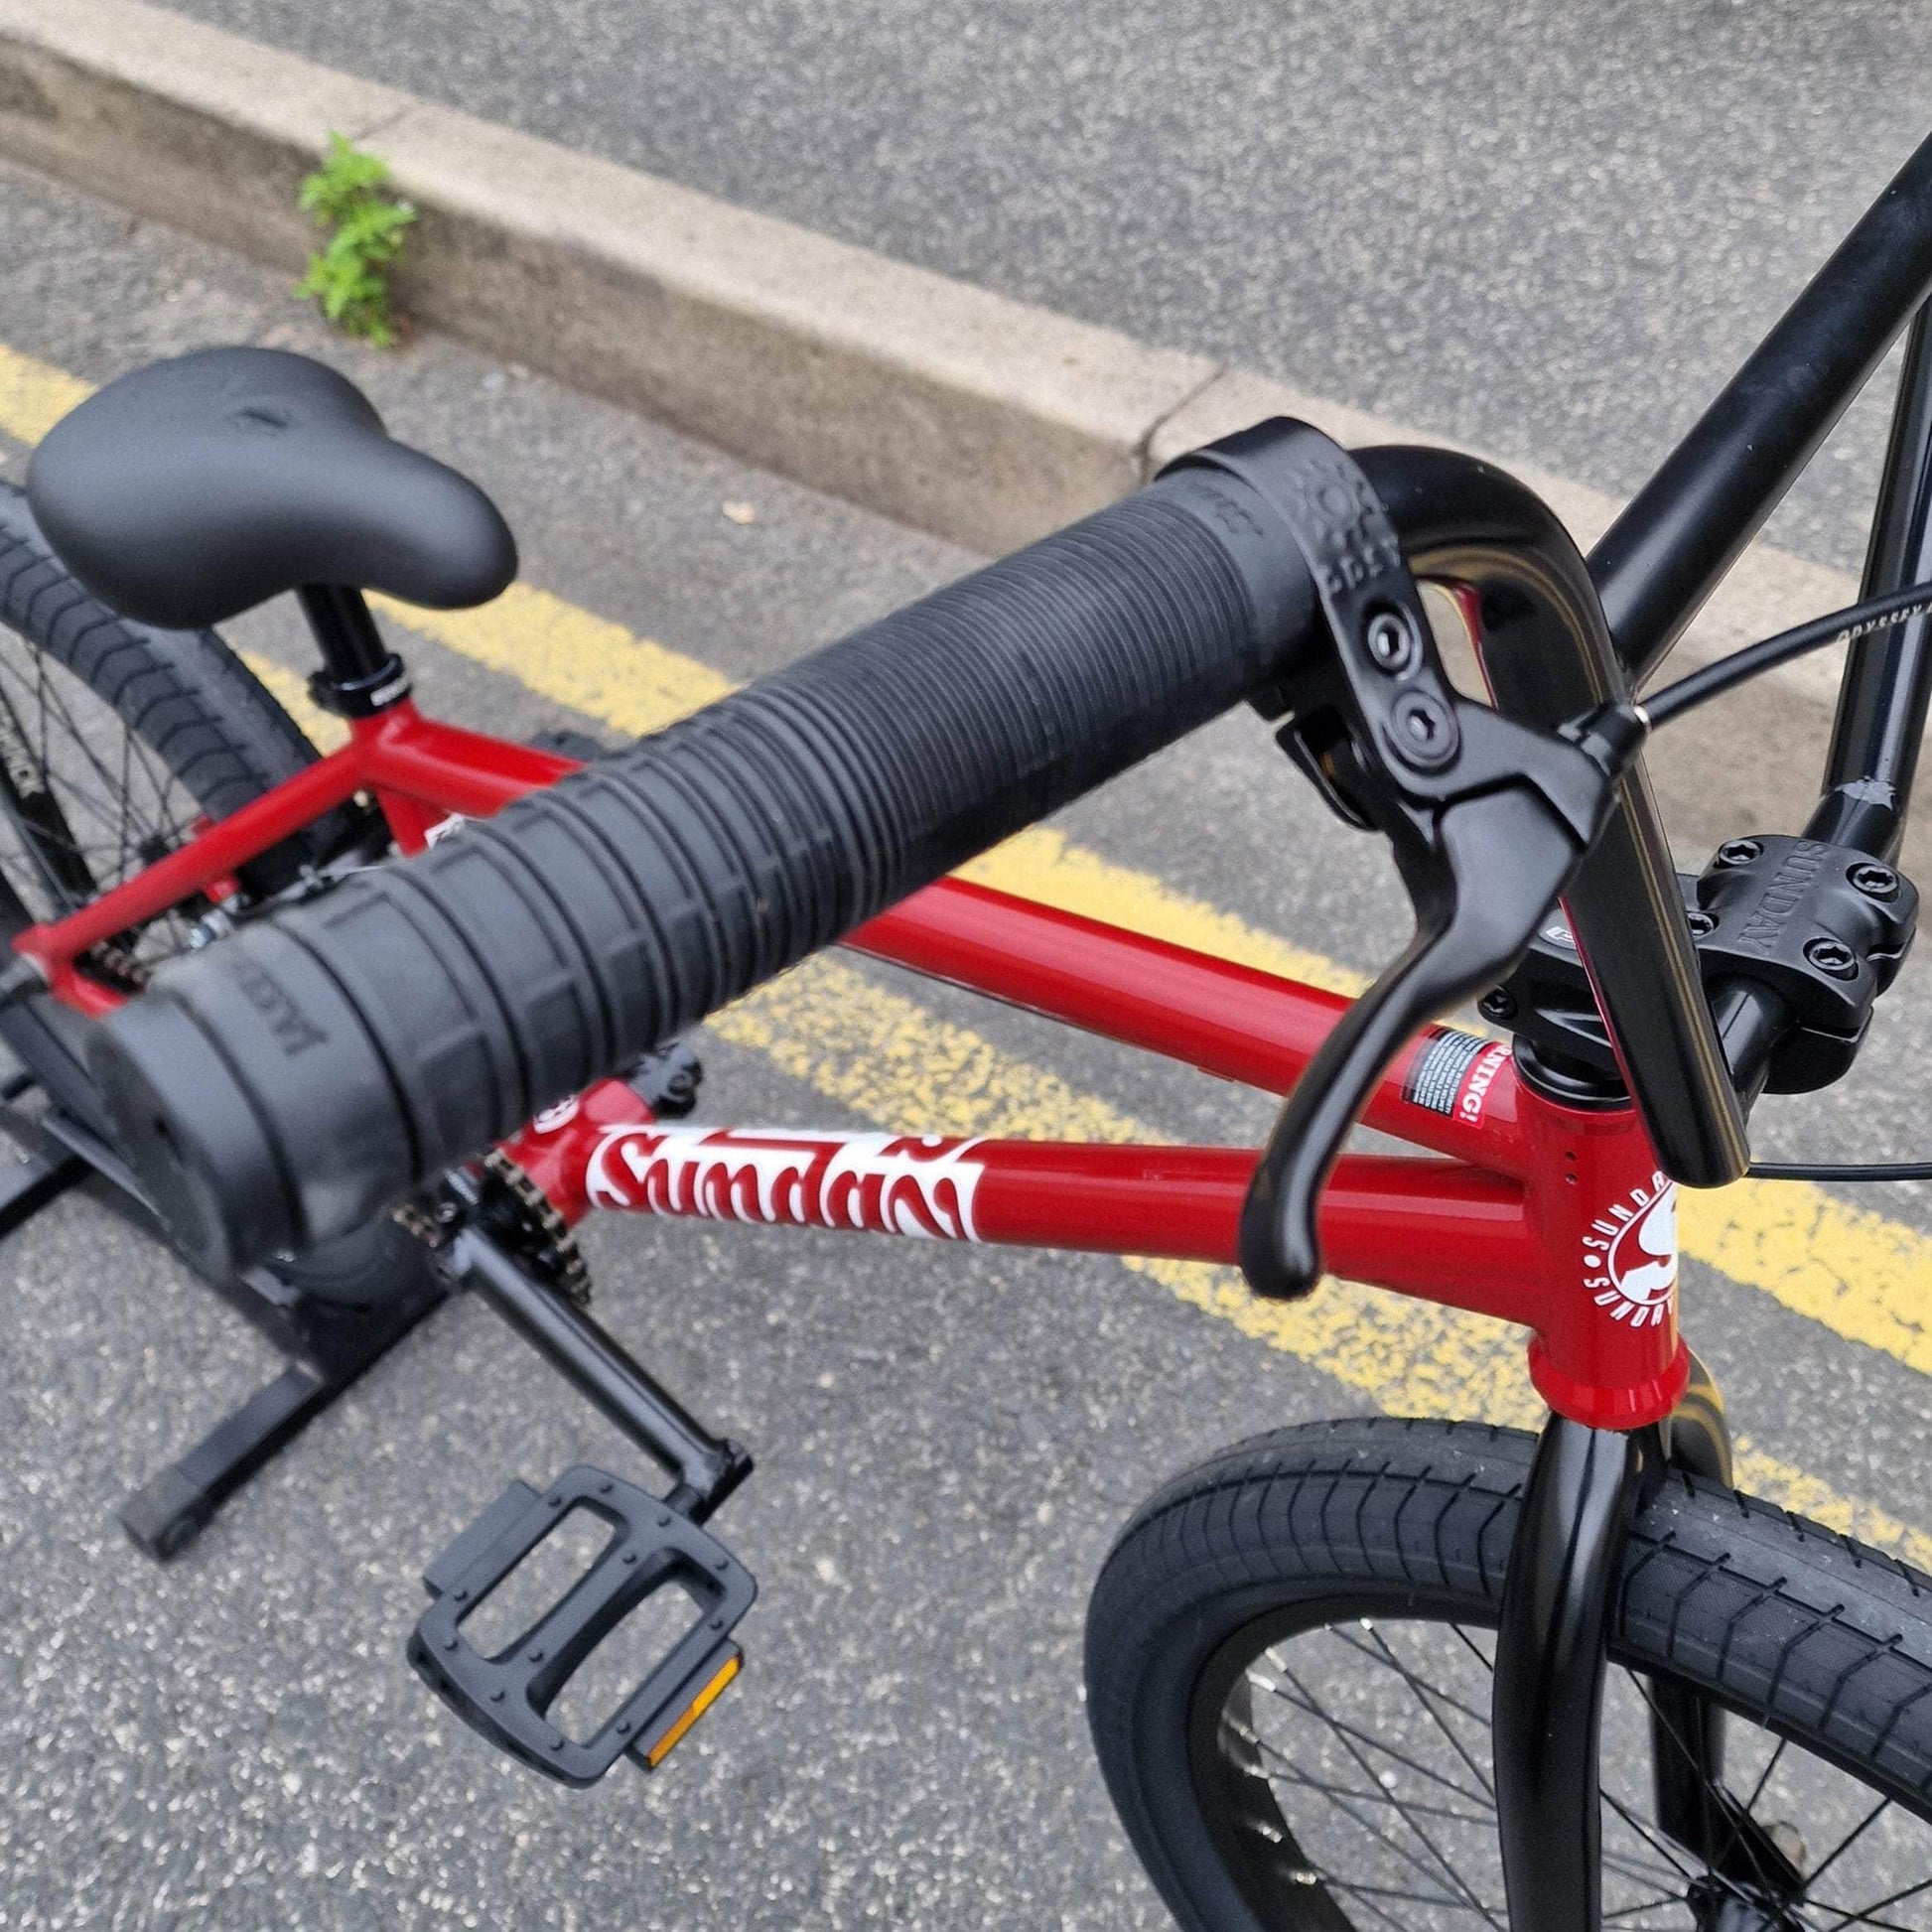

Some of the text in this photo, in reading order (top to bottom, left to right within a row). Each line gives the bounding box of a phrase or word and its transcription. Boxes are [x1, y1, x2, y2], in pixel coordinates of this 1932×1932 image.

[1736, 840, 1829, 957] SUNDAY
[1459, 1043, 1512, 1123] RNING!
[1582, 1170, 1669, 1252] SUNDA
